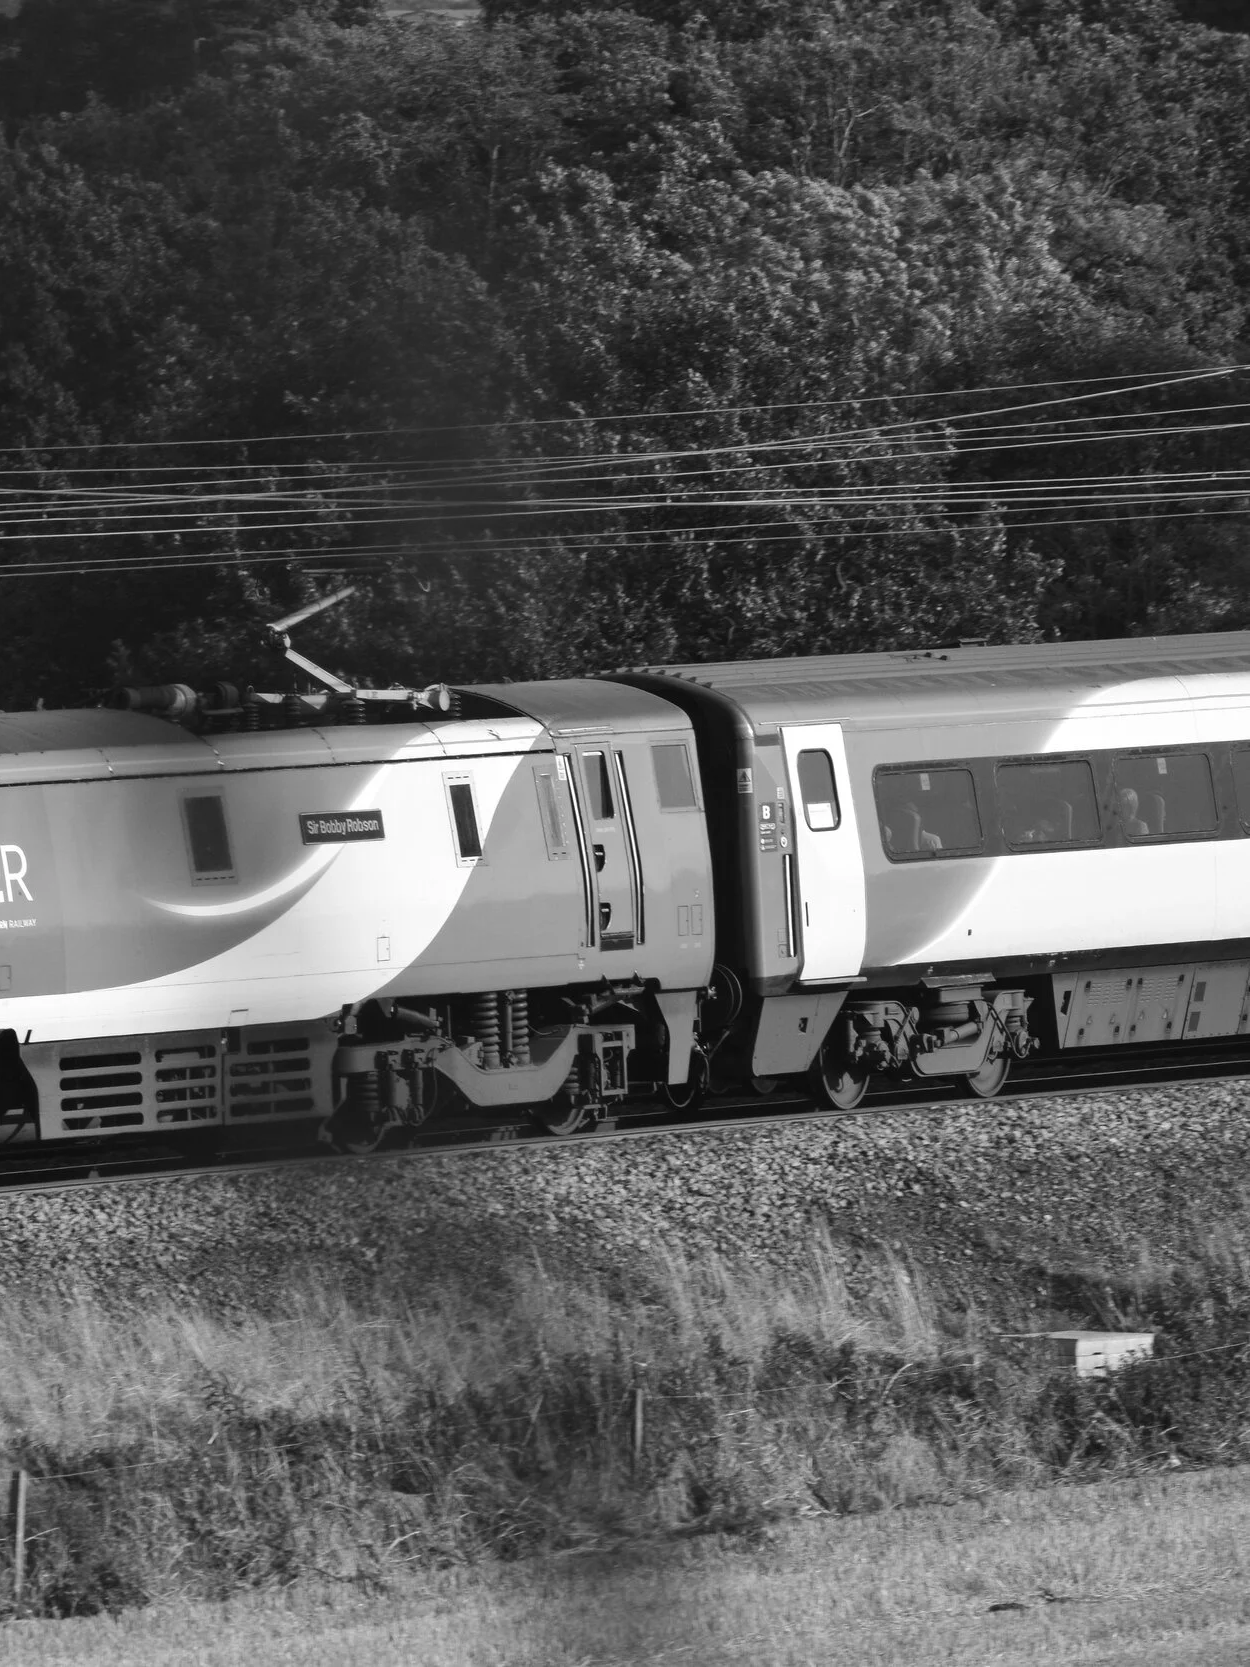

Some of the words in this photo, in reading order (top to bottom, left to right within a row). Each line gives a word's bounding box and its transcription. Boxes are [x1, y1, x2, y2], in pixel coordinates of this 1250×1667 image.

[762, 804, 771, 820] B
[306, 820, 319, 835] Sir
[319, 819, 346, 835] Bobby
[346, 818, 379, 833] Robson
[8, 918, 37, 929] RAILWAY
